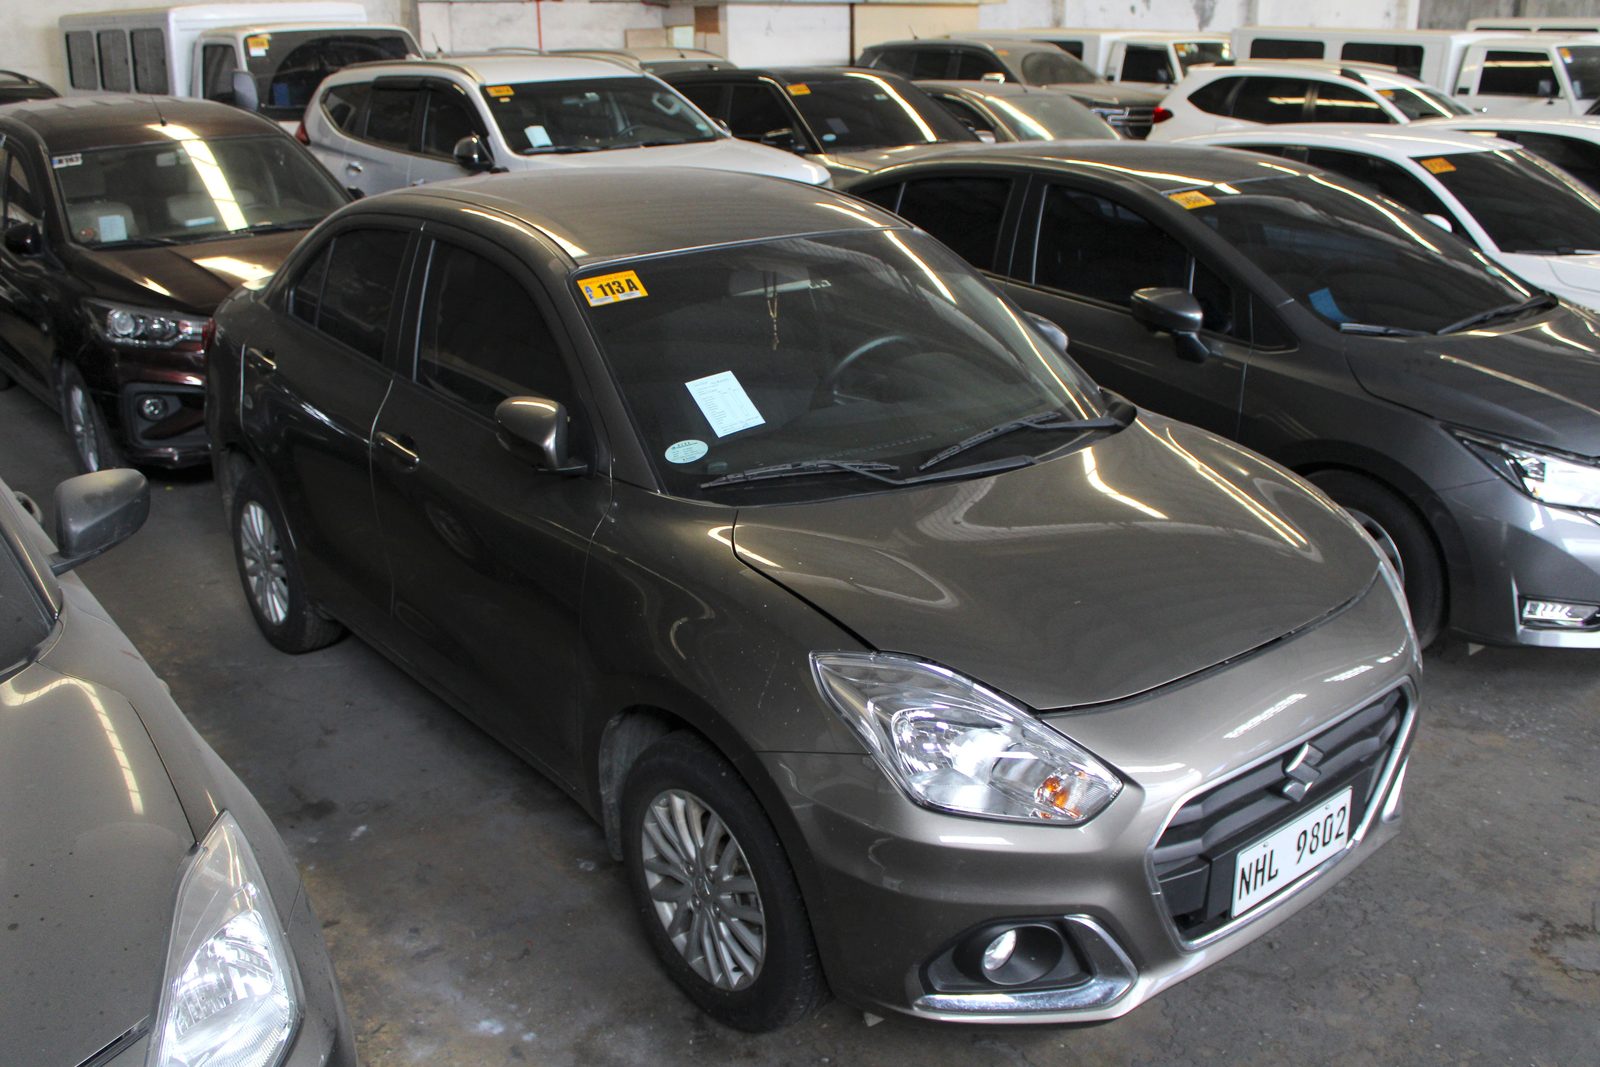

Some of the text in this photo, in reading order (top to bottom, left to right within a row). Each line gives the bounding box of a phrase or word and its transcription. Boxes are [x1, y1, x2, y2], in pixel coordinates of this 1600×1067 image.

[597, 278, 639, 297] 113 A
[1238, 805, 1347, 900] NHL 9802
